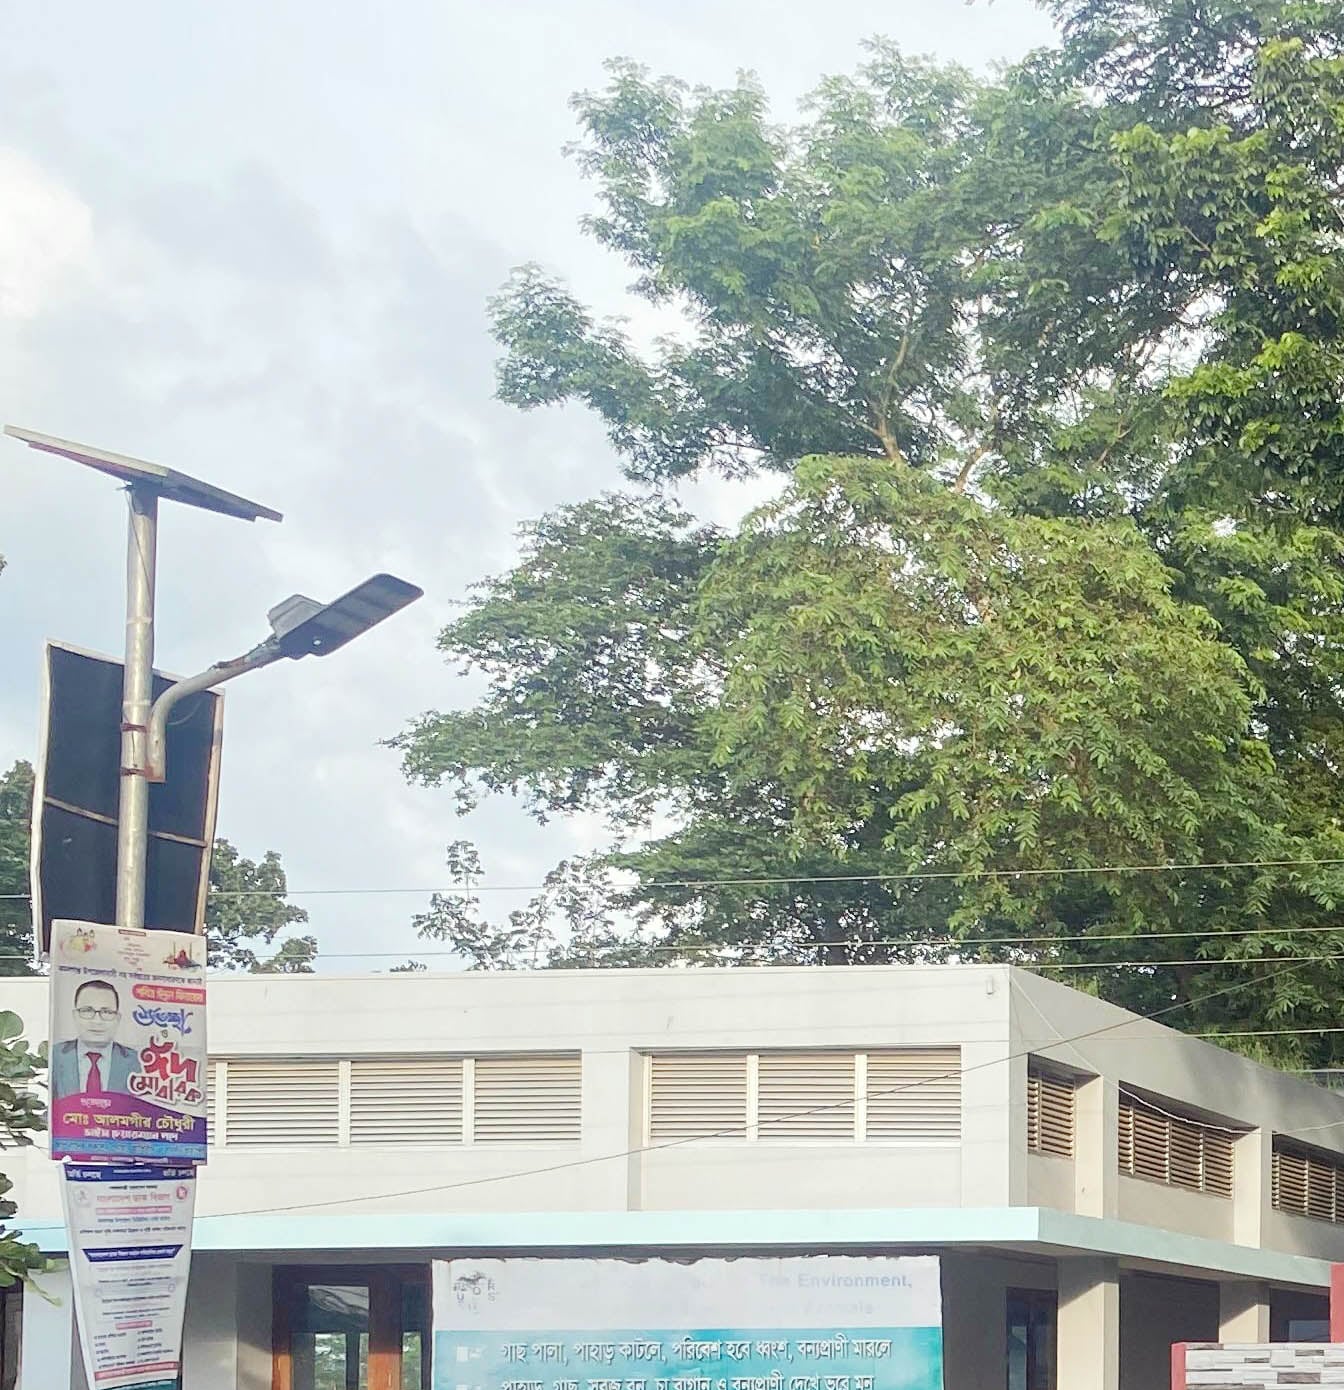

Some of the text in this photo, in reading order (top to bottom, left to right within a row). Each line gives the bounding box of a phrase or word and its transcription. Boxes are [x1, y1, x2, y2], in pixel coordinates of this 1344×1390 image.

[140, 1036, 198, 1082] ঈদ
[130, 1075, 202, 1102] মোবারক
[93, 1112, 151, 1129] আলমগীর
[157, 1115, 195, 1133] চৌধুরী
[502, 1342, 527, 1364] গাছ
[531, 1341, 568, 1366] পালা,
[573, 1341, 616, 1365] পাহাড়
[618, 1337, 668, 1365] কাটলে,
[672, 1335, 722, 1362] পরিবেশ
[725, 1339, 752, 1361] হবে
[796, 1332, 850, 1361] বন্যপ্রাণী
[852, 1338, 892, 1360] মারলে
